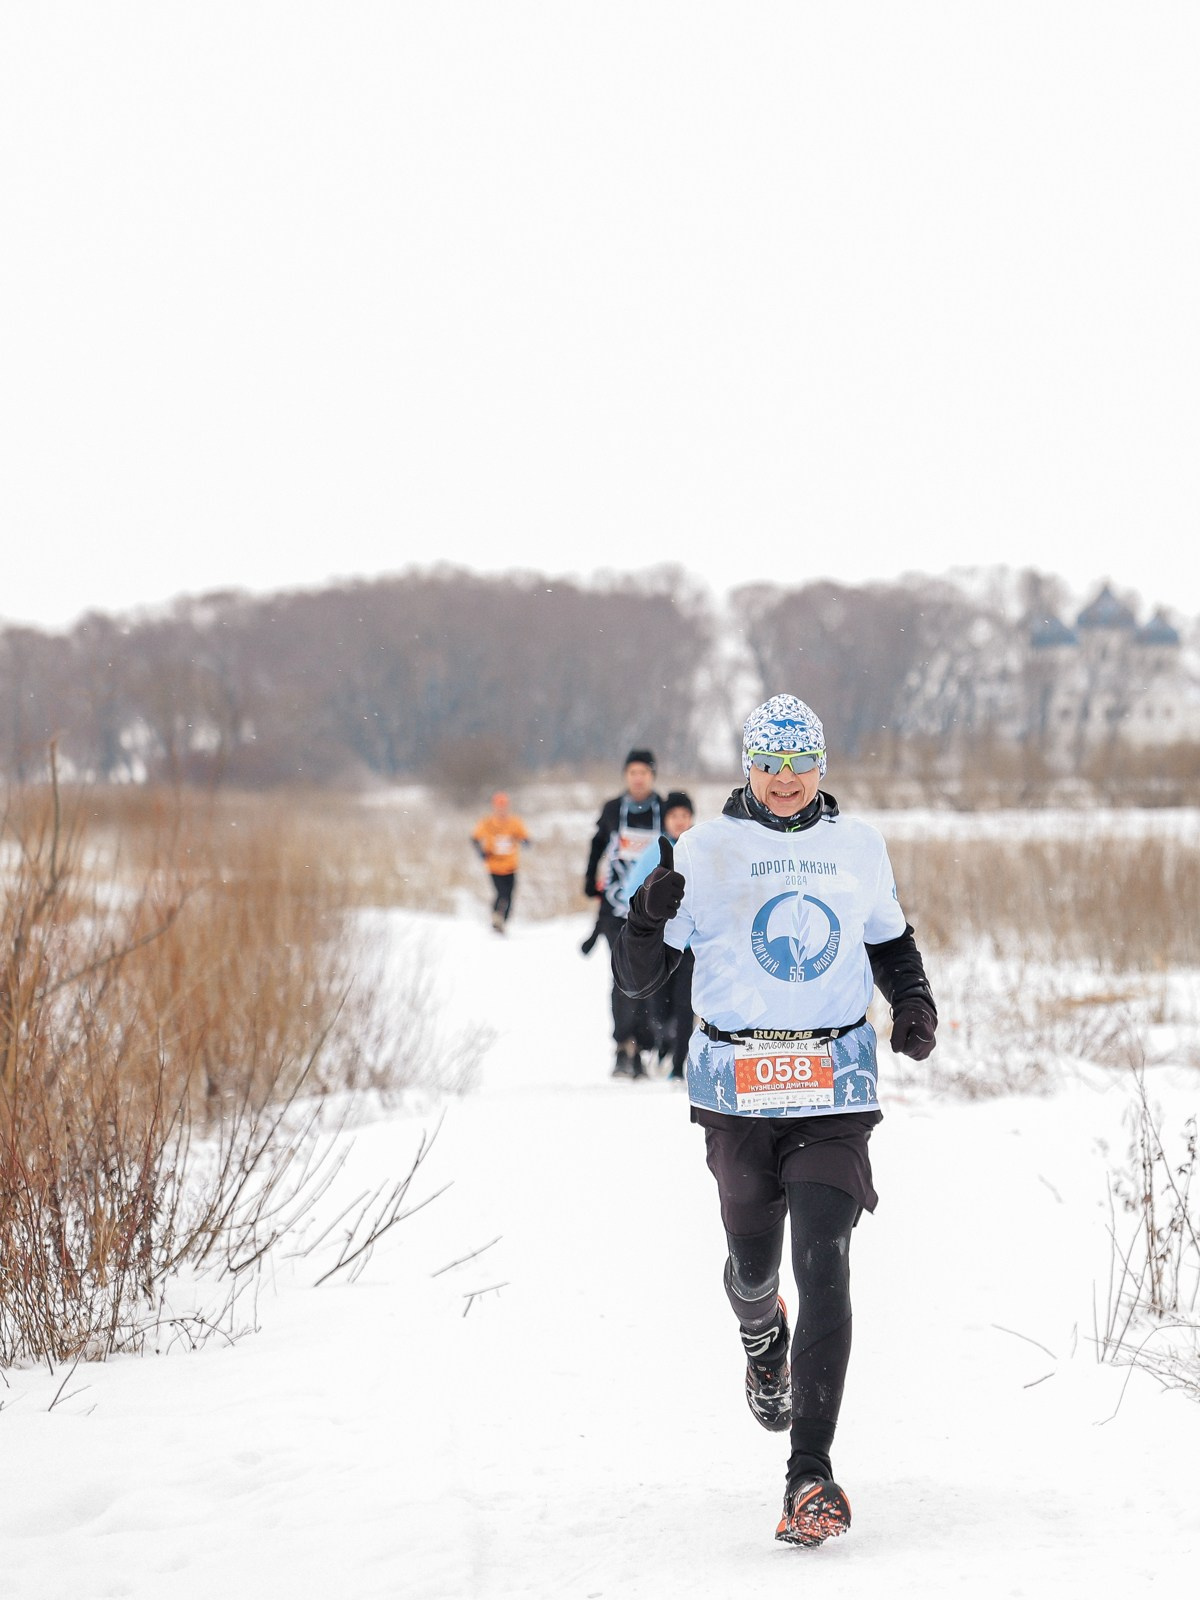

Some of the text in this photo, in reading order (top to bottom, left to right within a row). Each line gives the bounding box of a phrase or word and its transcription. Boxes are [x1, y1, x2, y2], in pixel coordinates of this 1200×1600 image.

[751, 859, 837, 877] ДОРОГА ЖИЗНИ
[785, 875, 808, 886] 2024
[751, 930, 841, 982] ЗИМНИЙ 55 МАРАФОН
[753, 1030, 813, 1040] RUNLAB
[758, 1041, 808, 1051] NOVGOROD ICE
[756, 1058, 813, 1083] 058
[750, 1081, 819, 1092] КУЗНЕЦОВ ДМИТРИЙ
